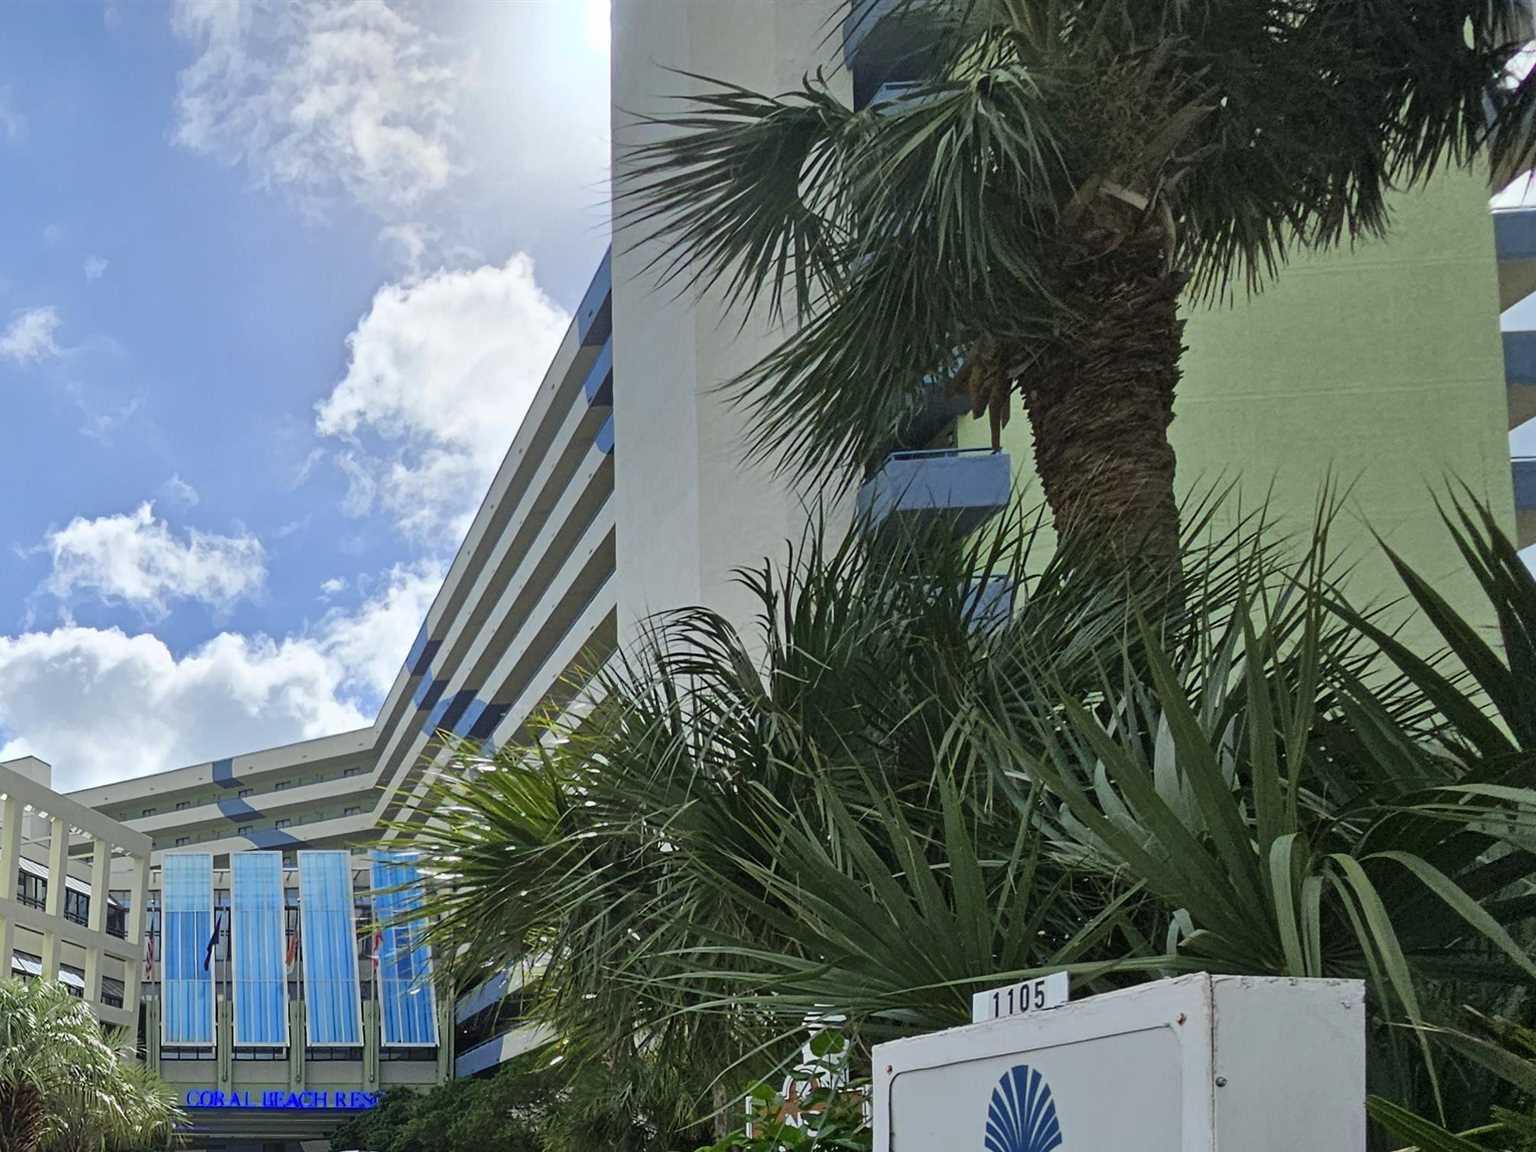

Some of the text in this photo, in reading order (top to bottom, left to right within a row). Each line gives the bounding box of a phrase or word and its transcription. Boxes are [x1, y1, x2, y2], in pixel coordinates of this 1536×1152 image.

[992, 980, 1047, 1018] 1105
[186, 1090, 254, 1106] CORAL
[262, 1090, 328, 1107] BEACH
